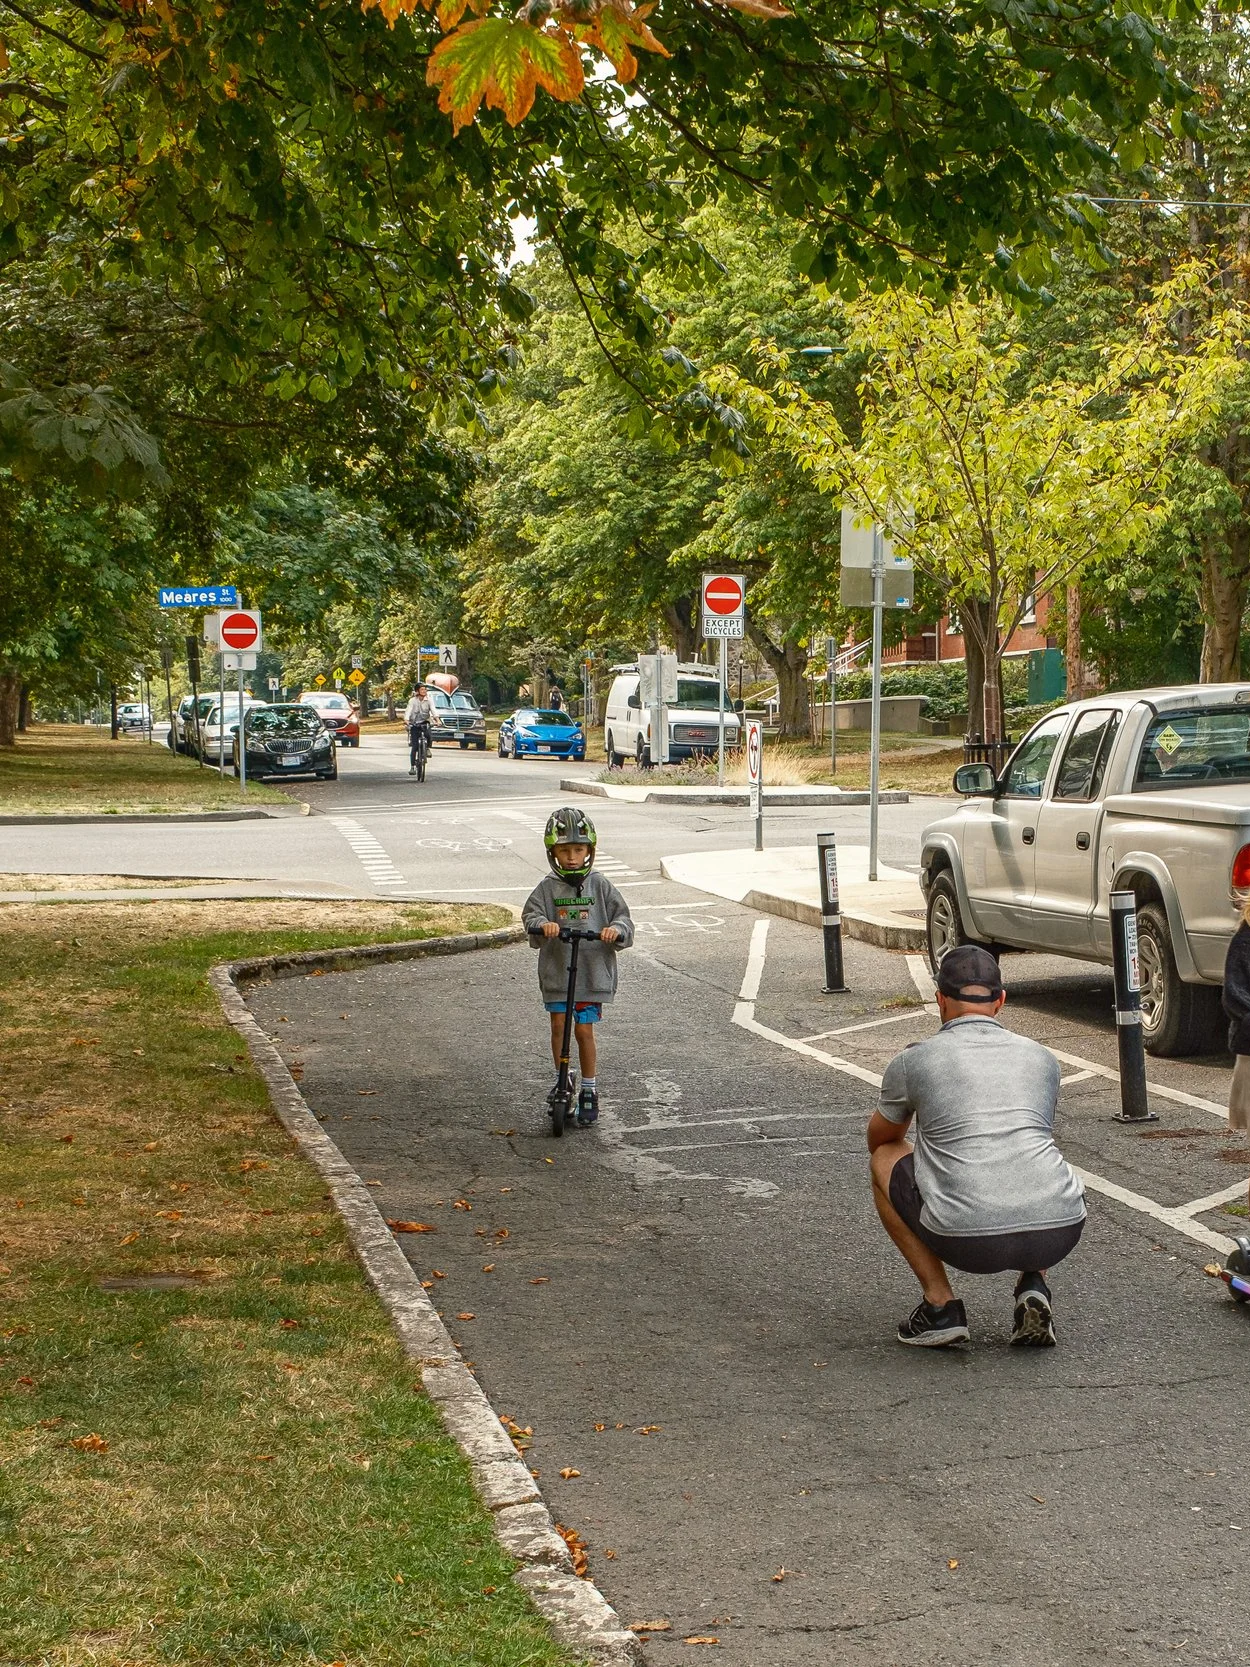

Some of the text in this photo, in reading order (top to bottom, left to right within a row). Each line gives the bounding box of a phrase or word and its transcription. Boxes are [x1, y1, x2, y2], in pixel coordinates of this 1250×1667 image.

[162, 591, 217, 604] Meares
[705, 619, 741, 628] EXCEPT
[704, 627, 742, 636] BICYCLES
